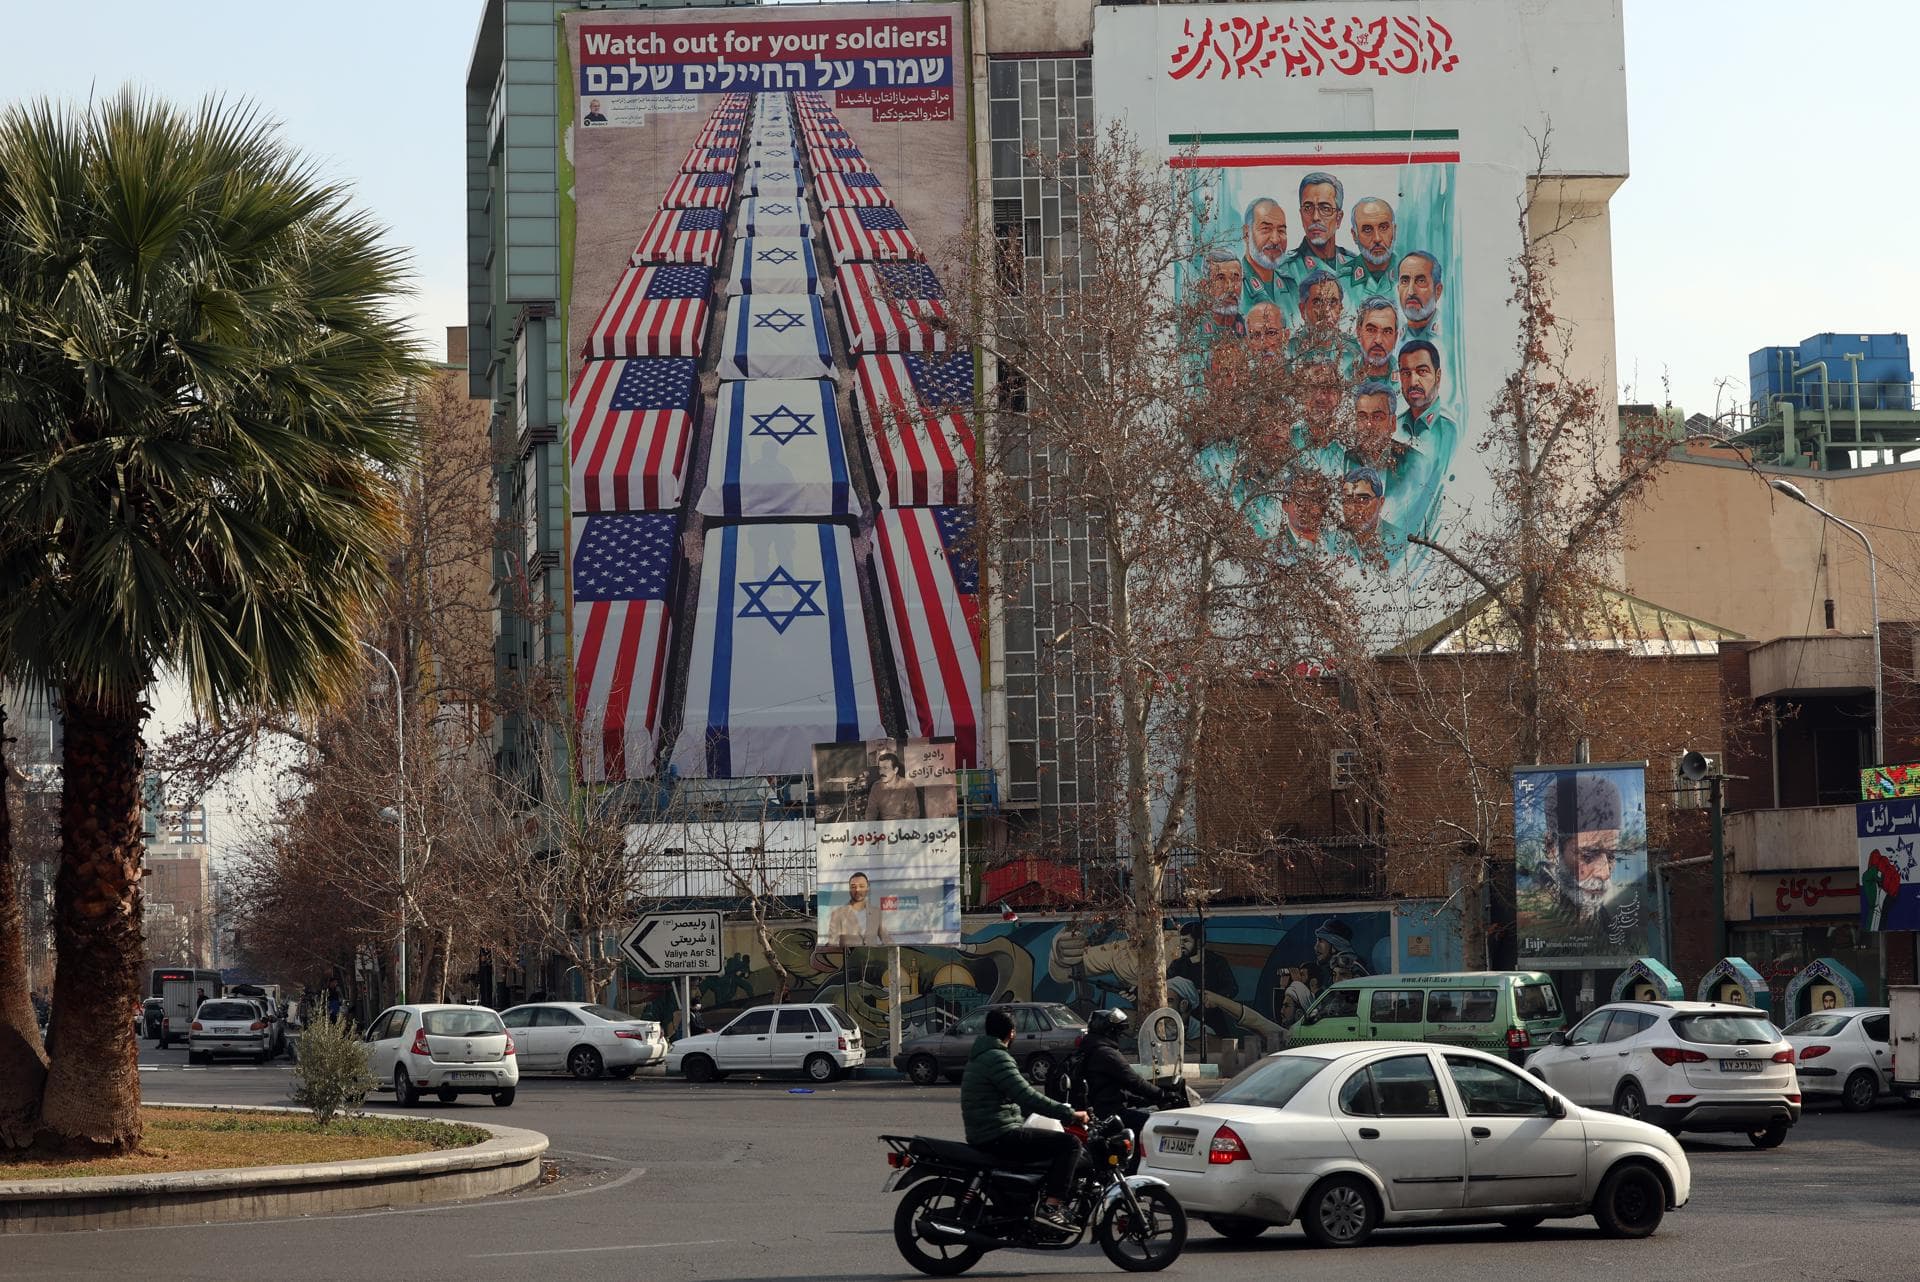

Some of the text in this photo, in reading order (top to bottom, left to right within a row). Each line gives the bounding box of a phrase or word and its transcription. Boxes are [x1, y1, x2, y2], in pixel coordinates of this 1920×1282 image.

[585, 25, 948, 58] Watch out for your soldiers!
[586, 53, 945, 92] שמרו על החיילים שלכם
[840, 92, 873, 105] باشید!
[920, 89, 950, 104] مراقب
[922, 749, 945, 761] رادیو
[909, 765, 933, 778] آزادی
[1866, 803, 1917, 834] اسرائیل
[820, 828, 957, 847] مزدور همان مزدور است
[672, 918, 706, 931] ولیعصر
[671, 933, 707, 947] شریعتی
[664, 950, 688, 958] Valiye
[690, 949, 704, 957] Asr
[664, 960, 709, 968] Shari'ati St.
